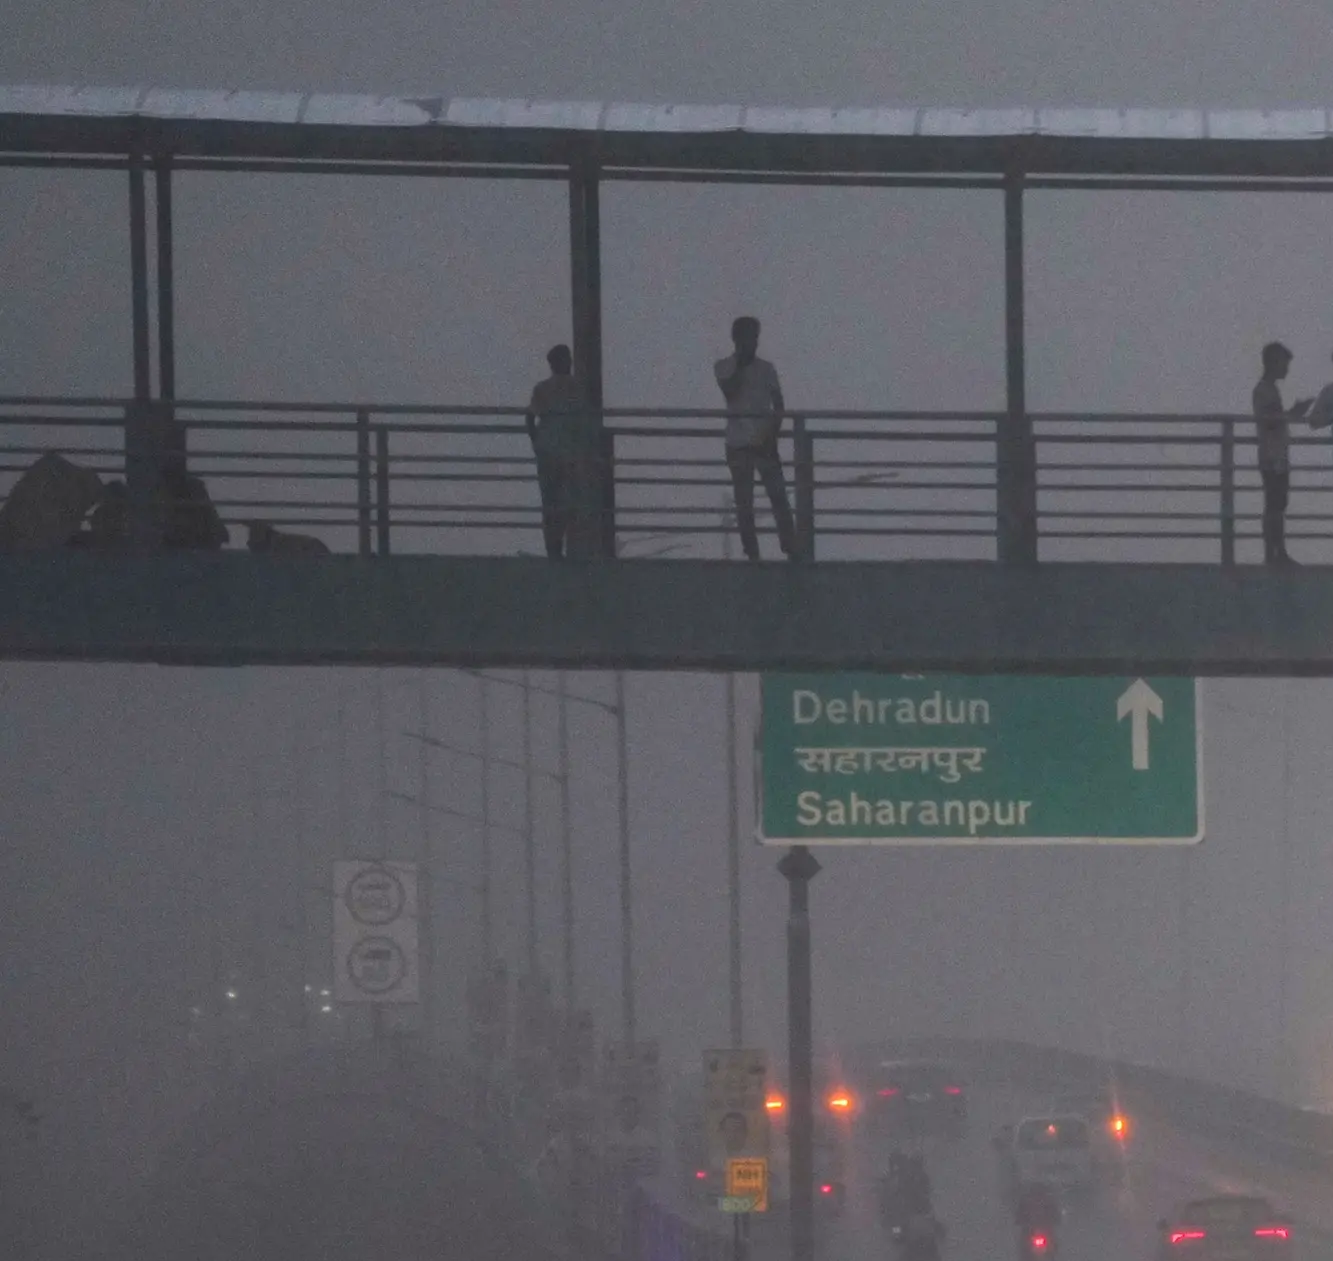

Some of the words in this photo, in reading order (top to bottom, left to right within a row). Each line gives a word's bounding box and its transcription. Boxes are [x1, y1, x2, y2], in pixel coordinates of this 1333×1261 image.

[793, 690, 990, 724] Dehradun
[794, 746, 987, 783] सहारनपुर
[797, 791, 1032, 834] Saharanpur
